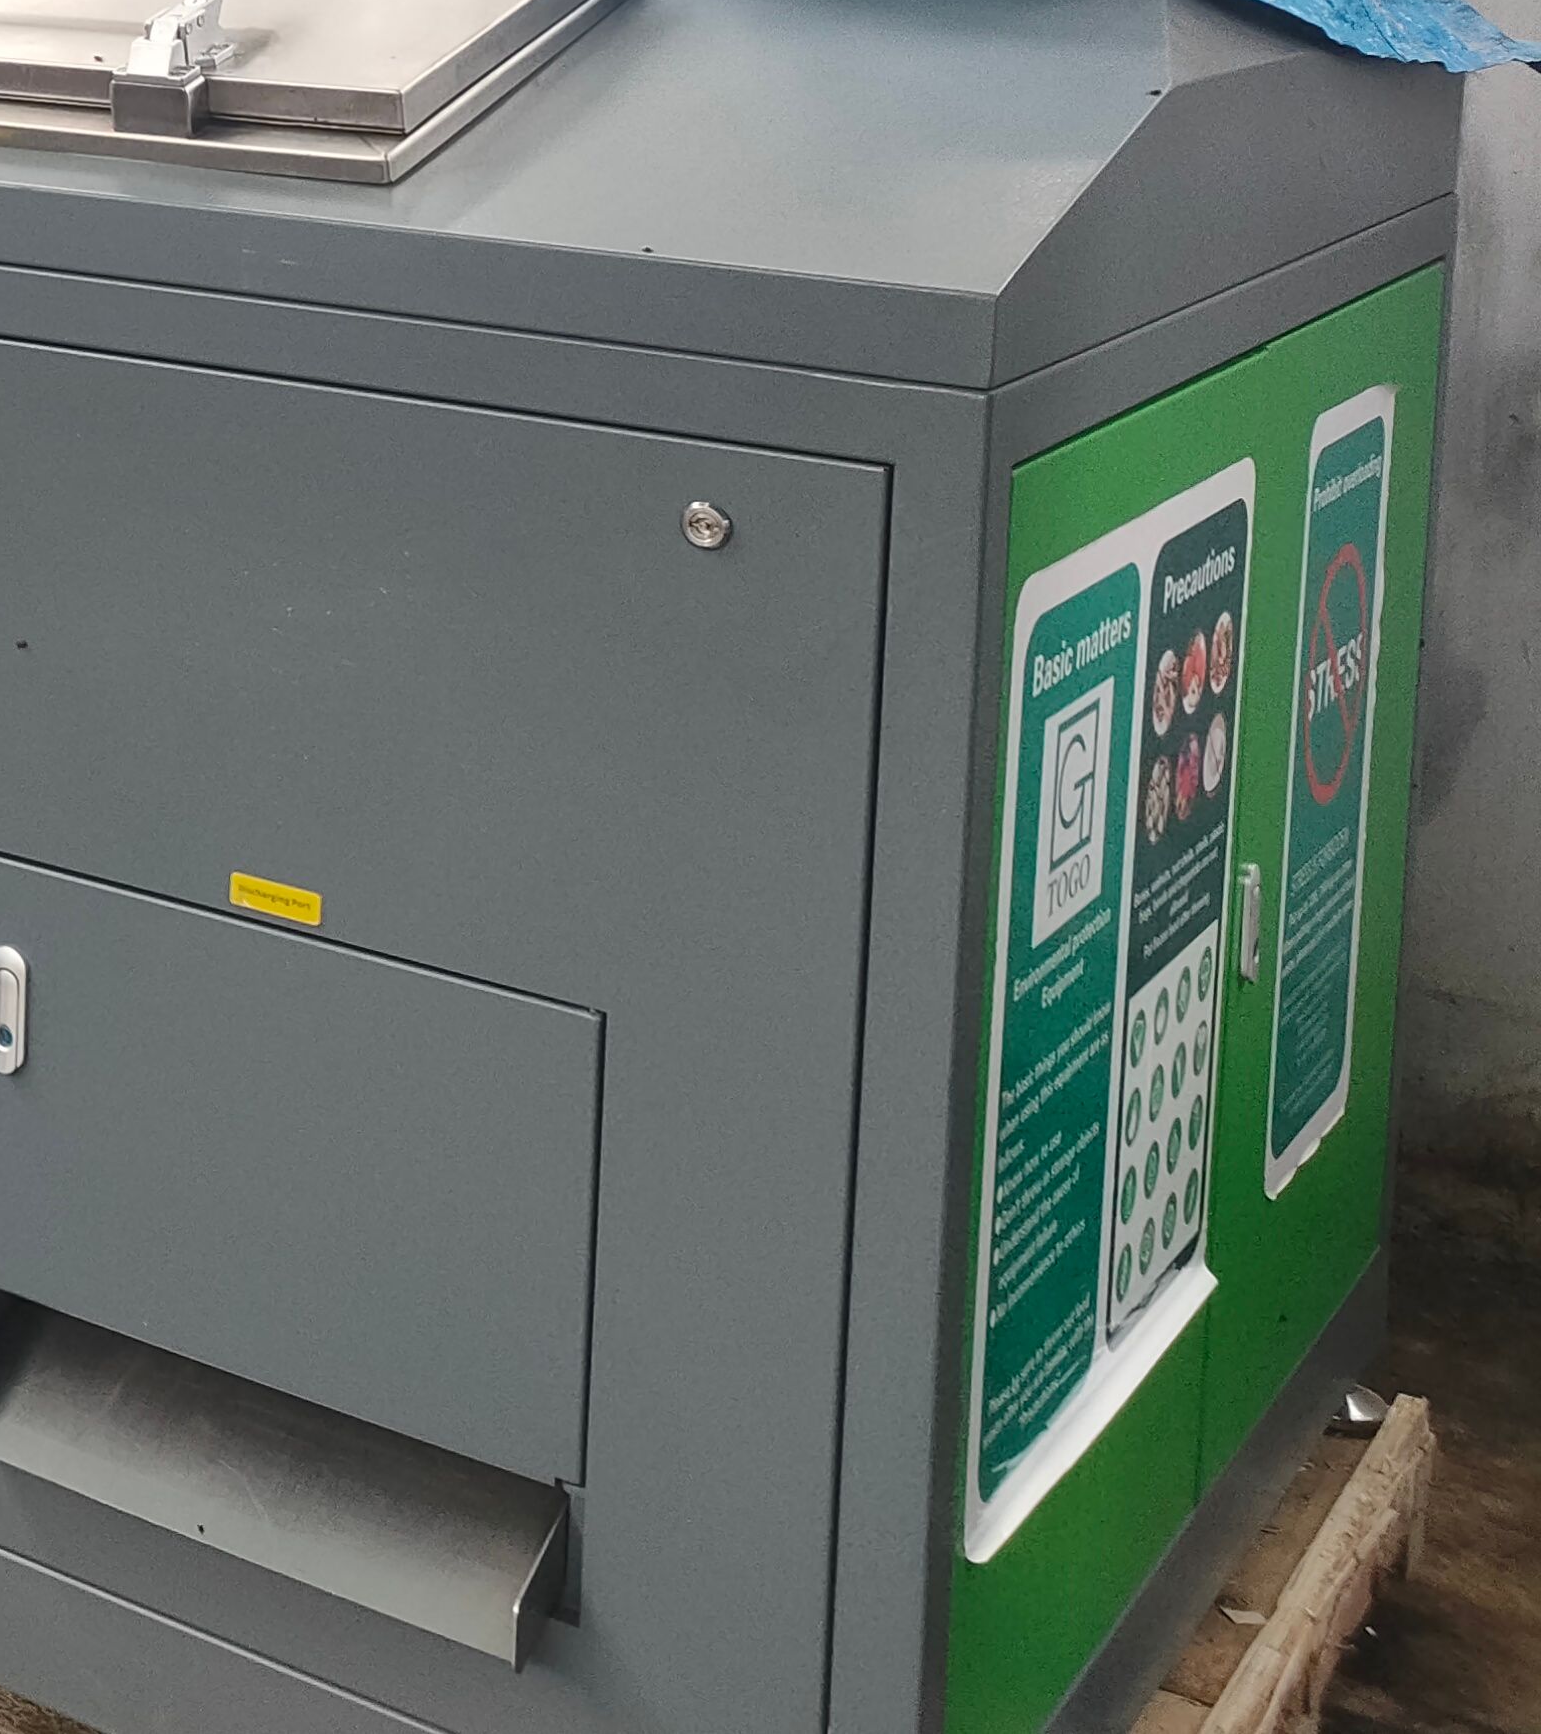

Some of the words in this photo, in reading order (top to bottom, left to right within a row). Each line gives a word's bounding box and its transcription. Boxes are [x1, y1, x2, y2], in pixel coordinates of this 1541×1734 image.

[1163, 545, 1236, 615] Precautions
[1032, 639, 1072, 698] Basic
[1076, 609, 1132, 670] matters
[1048, 852, 1091, 918] TOGO
[1042, 957, 1084, 1009] Equipment
